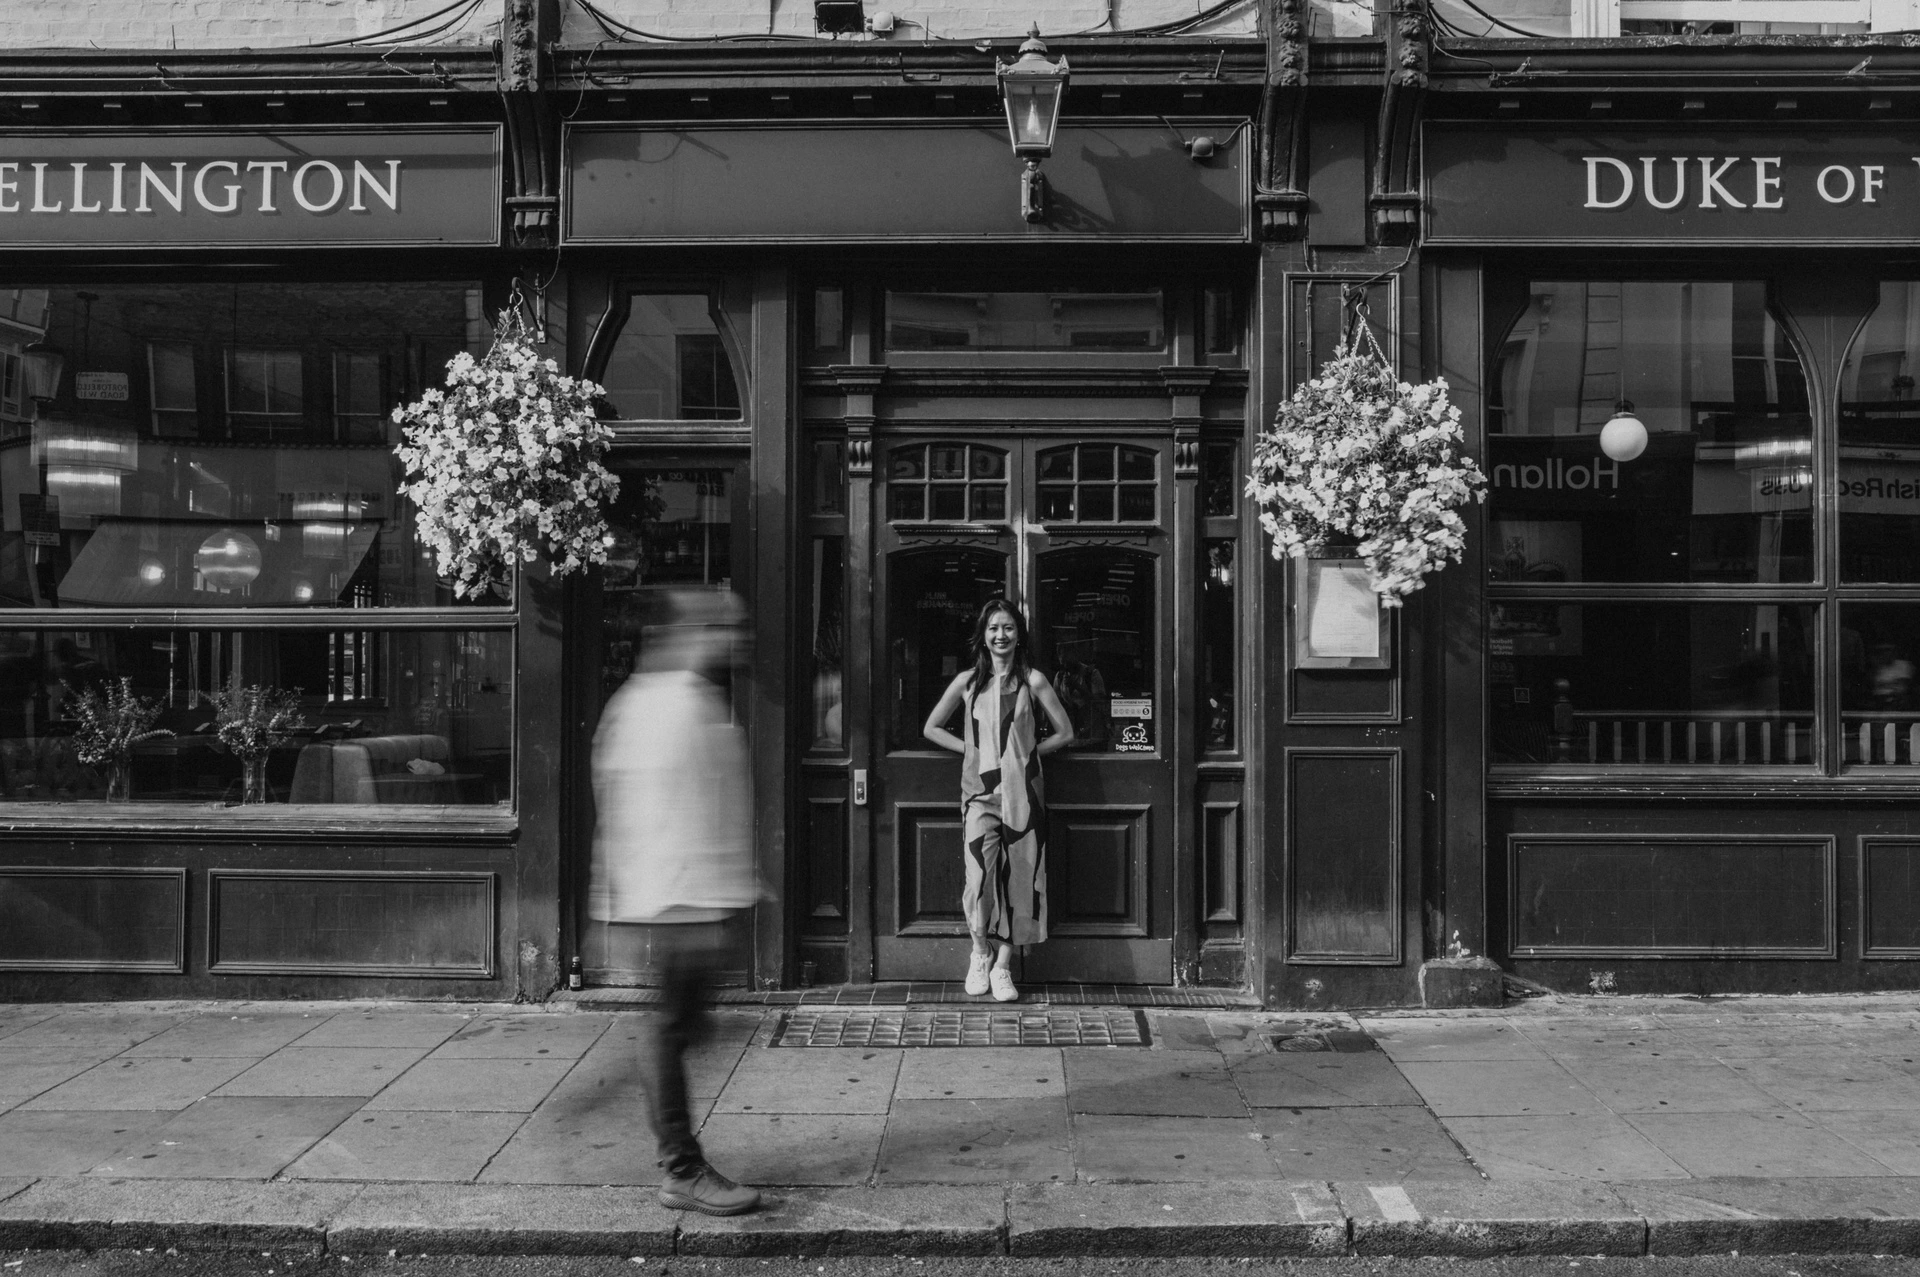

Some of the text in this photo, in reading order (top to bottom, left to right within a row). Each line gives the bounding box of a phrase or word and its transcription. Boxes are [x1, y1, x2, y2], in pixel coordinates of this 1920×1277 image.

[0, 160, 401, 212] ELLINGTON
[1582, 156, 1783, 209] DUKE
[1817, 165, 1884, 203] OF
